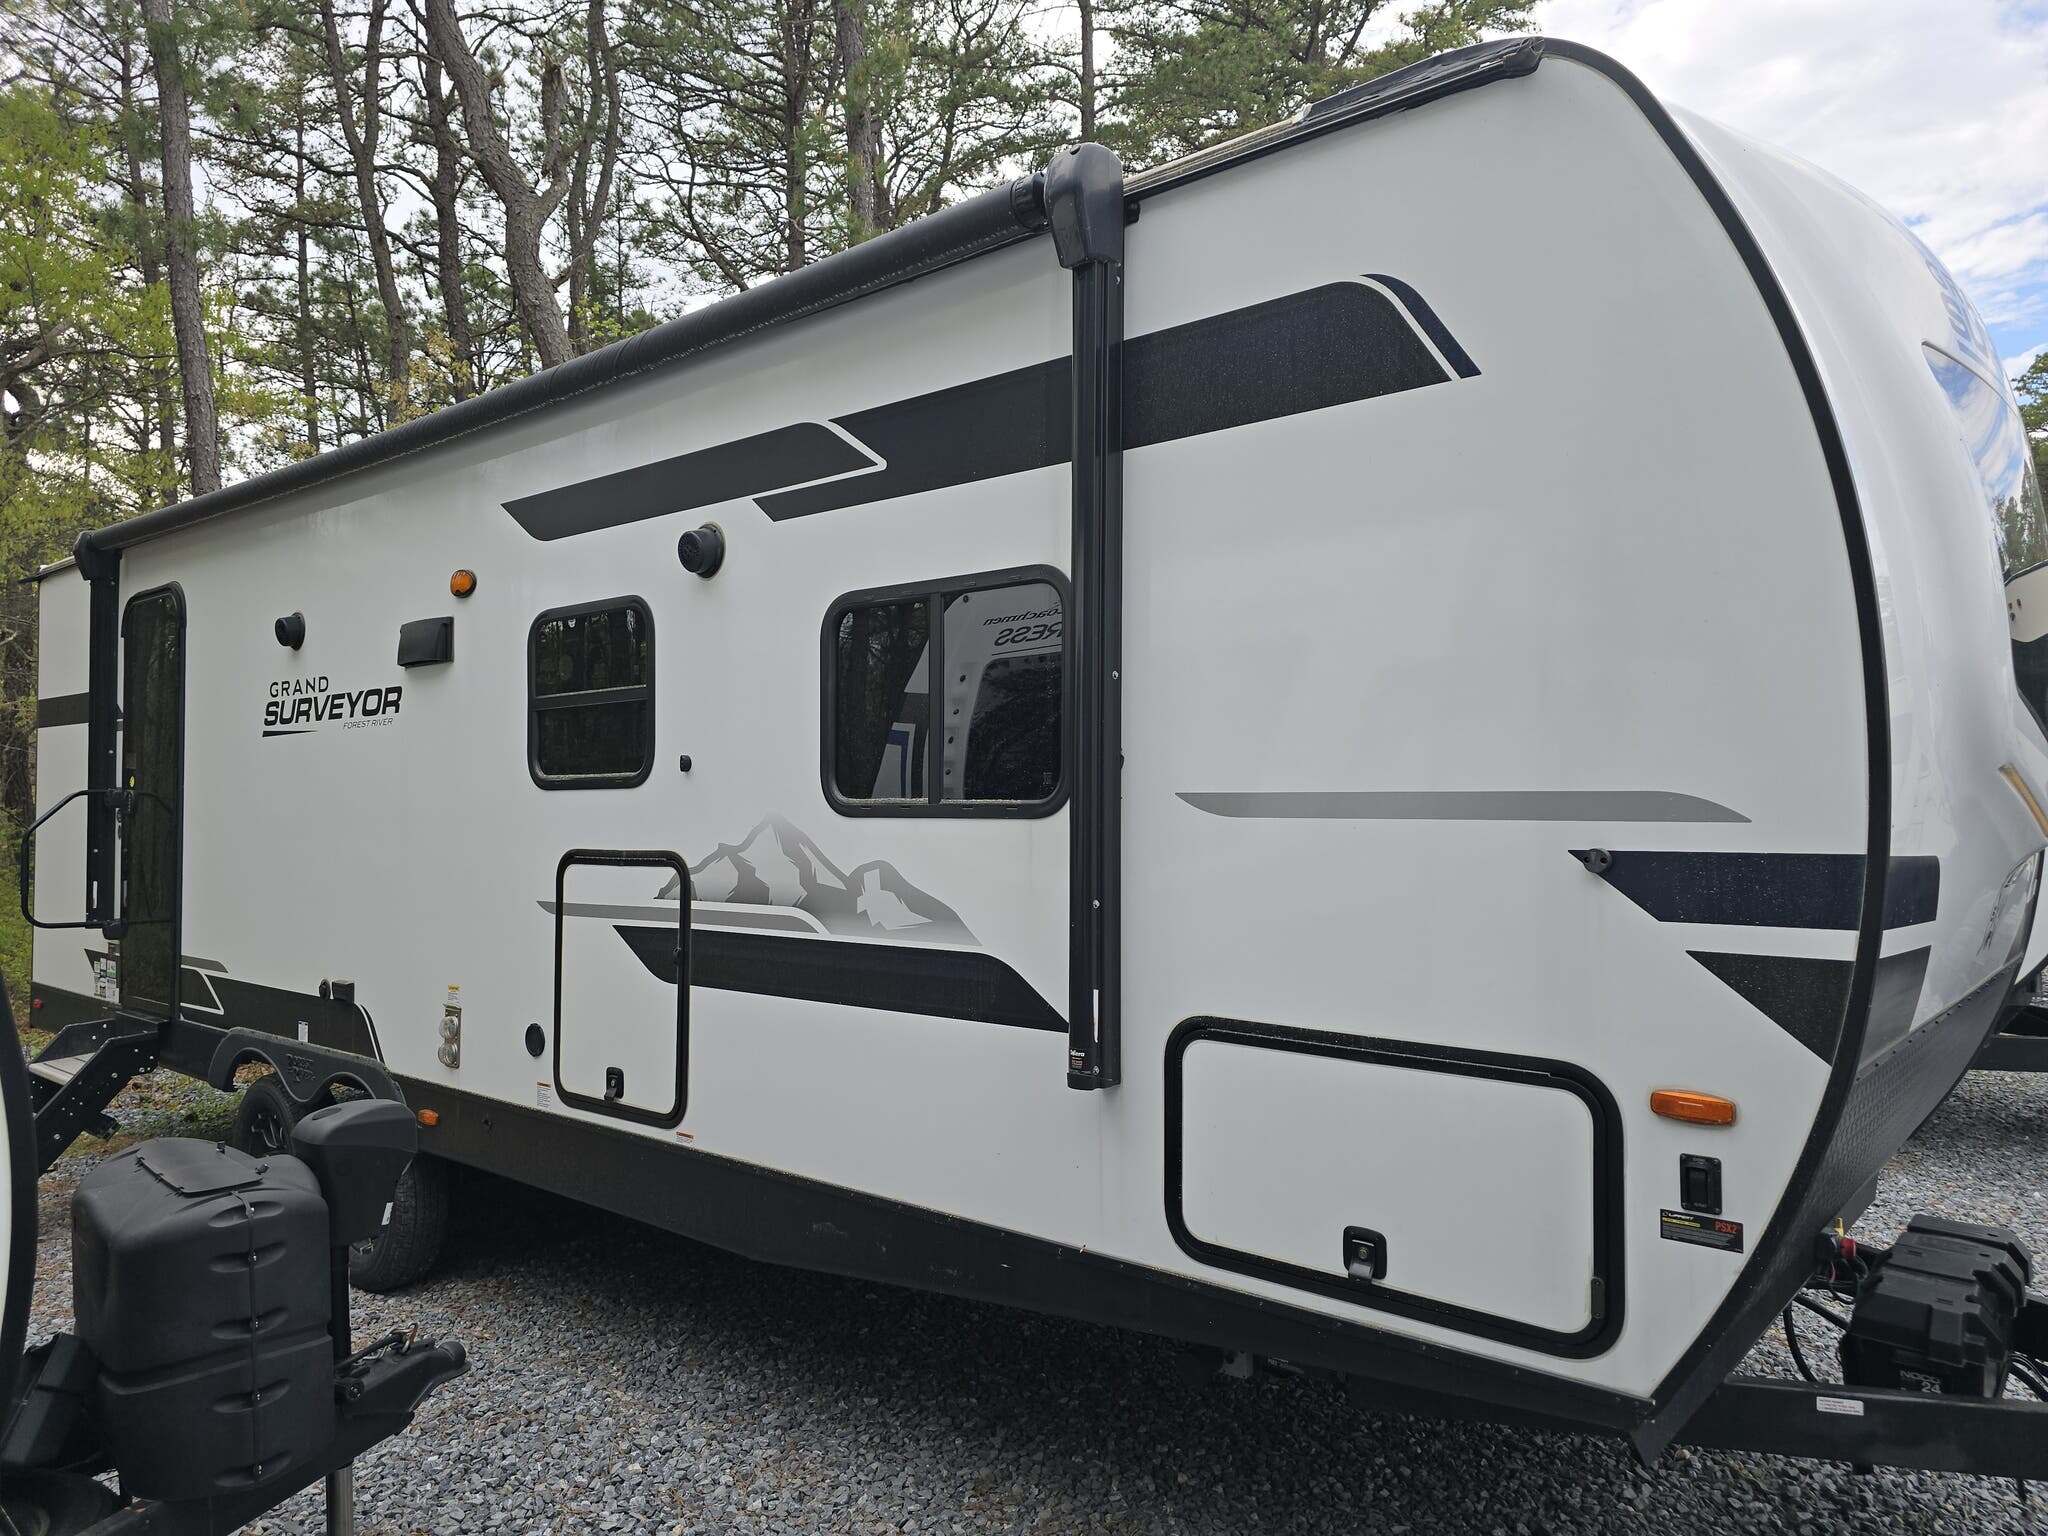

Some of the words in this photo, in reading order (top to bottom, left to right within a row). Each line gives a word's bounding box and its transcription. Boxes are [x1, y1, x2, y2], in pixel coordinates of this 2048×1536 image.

[269, 676, 329, 698] GRAND
[264, 686, 402, 726] SURVEYOR
[343, 719, 371, 729] FOREST
[371, 718, 393, 727] RIVER
[1714, 1220, 1737, 1233] PSX2
[1921, 1381, 1941, 1394] 24
